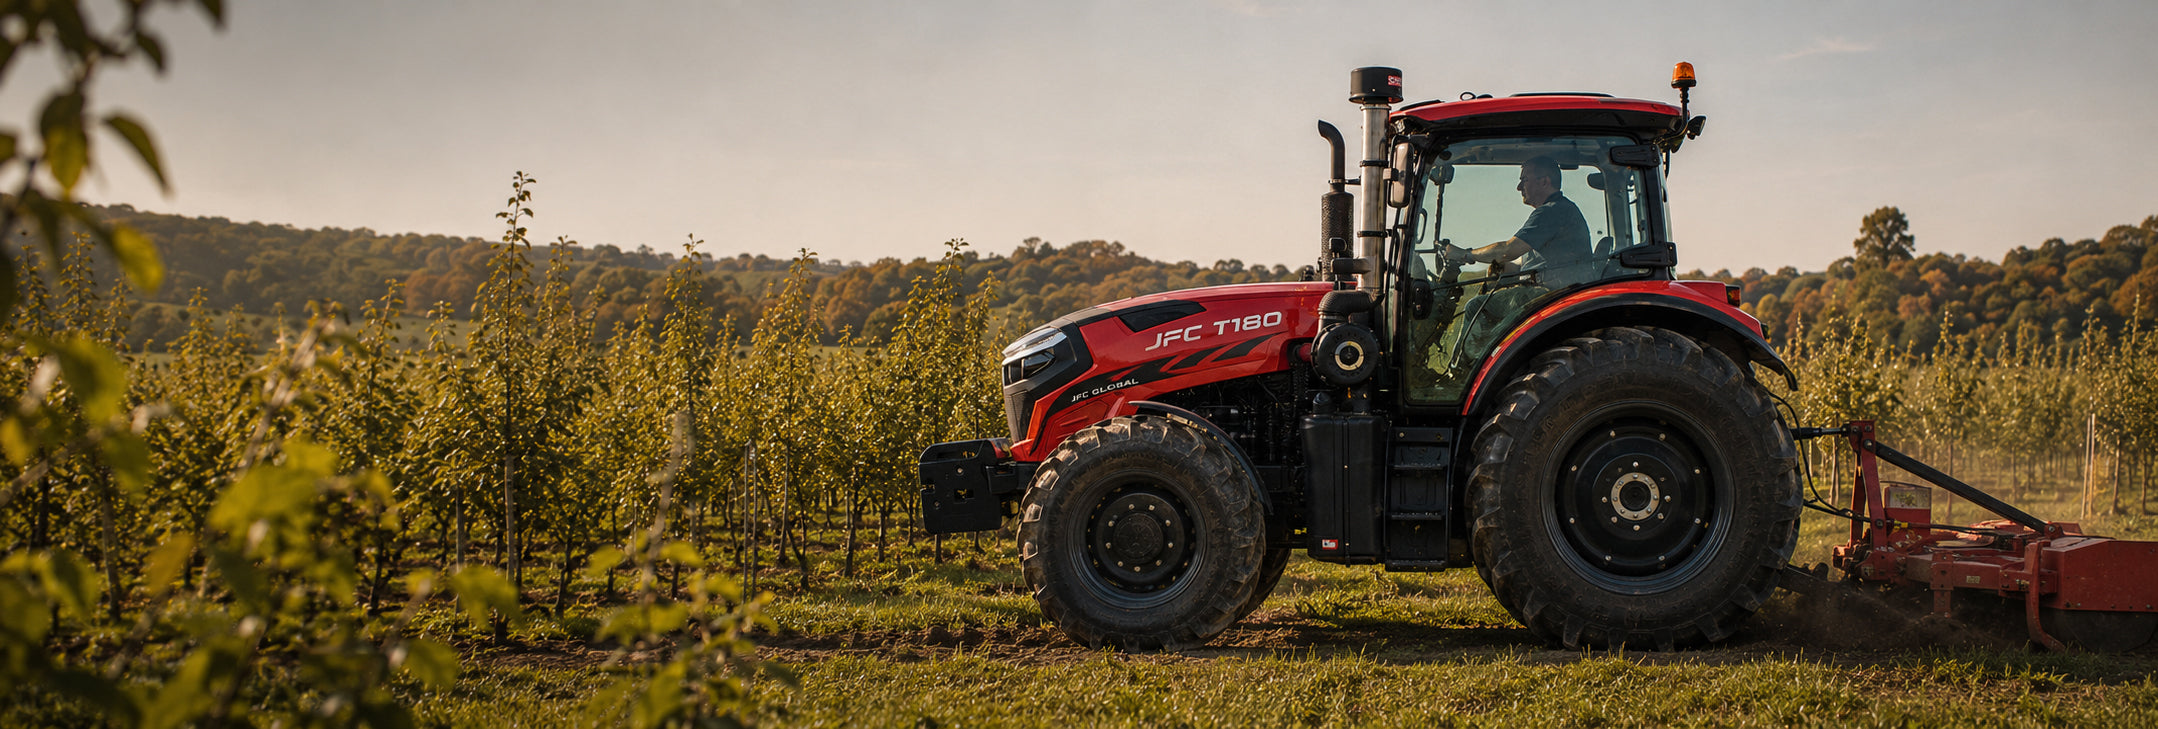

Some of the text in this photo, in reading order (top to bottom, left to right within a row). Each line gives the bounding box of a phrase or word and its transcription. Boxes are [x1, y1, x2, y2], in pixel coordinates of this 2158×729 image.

[1145, 311, 1282, 352] JFC T180
[1071, 378, 1139, 403] JFC GLOBAL
